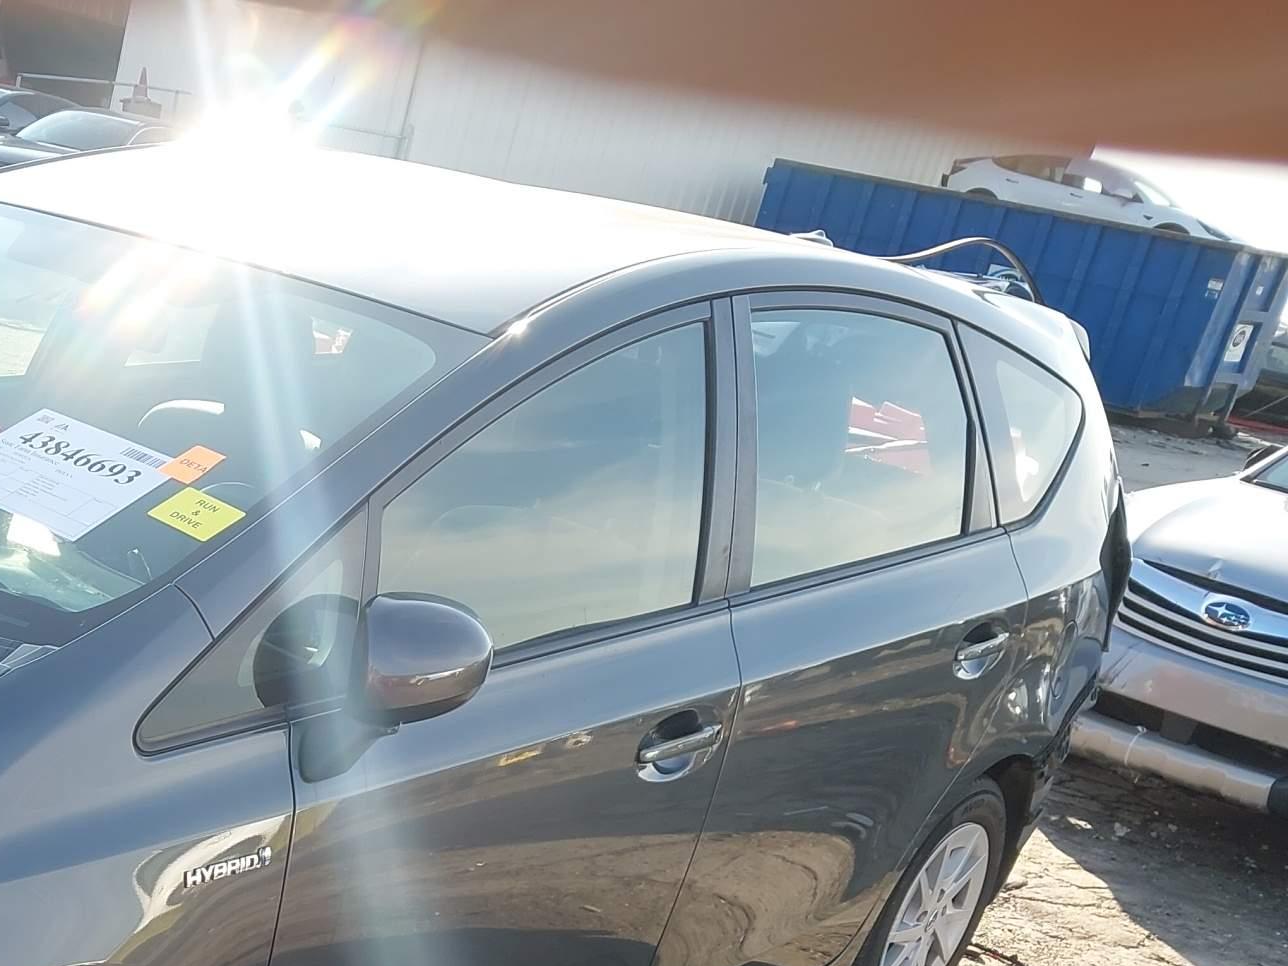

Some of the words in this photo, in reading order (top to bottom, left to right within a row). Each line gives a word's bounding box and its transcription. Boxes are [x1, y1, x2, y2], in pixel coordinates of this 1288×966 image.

[19, 431, 142, 485] 43846693
[179, 458, 208, 474] DETA
[194, 499, 220, 514] RUN
[168, 512, 203, 530] DRIVE
[184, 853, 261, 888] HYBRID
